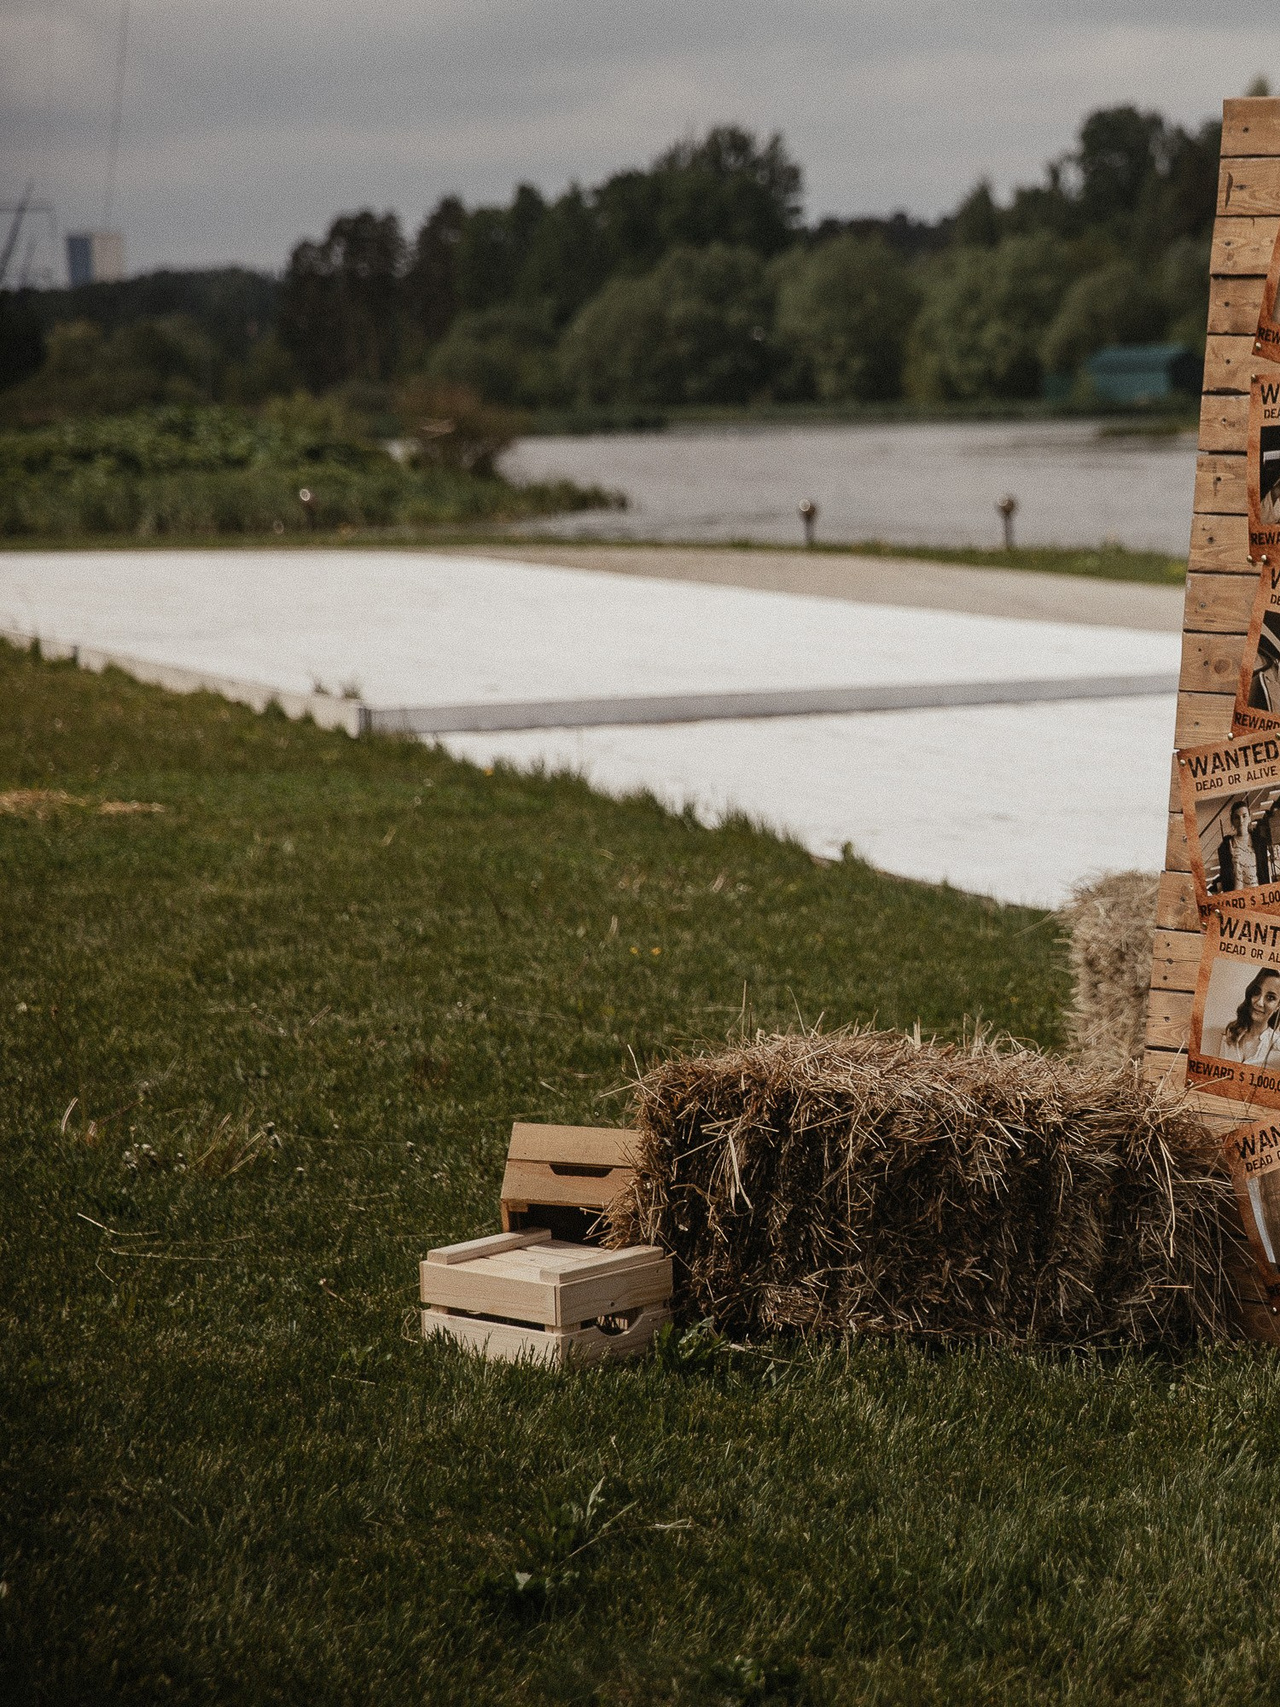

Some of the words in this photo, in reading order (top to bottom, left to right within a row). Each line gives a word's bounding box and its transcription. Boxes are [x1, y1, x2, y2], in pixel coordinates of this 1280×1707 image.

[1187, 739, 1279, 778] WANTED
[1219, 941, 1246, 955] DEAD
[1250, 948, 1263, 959] OR
